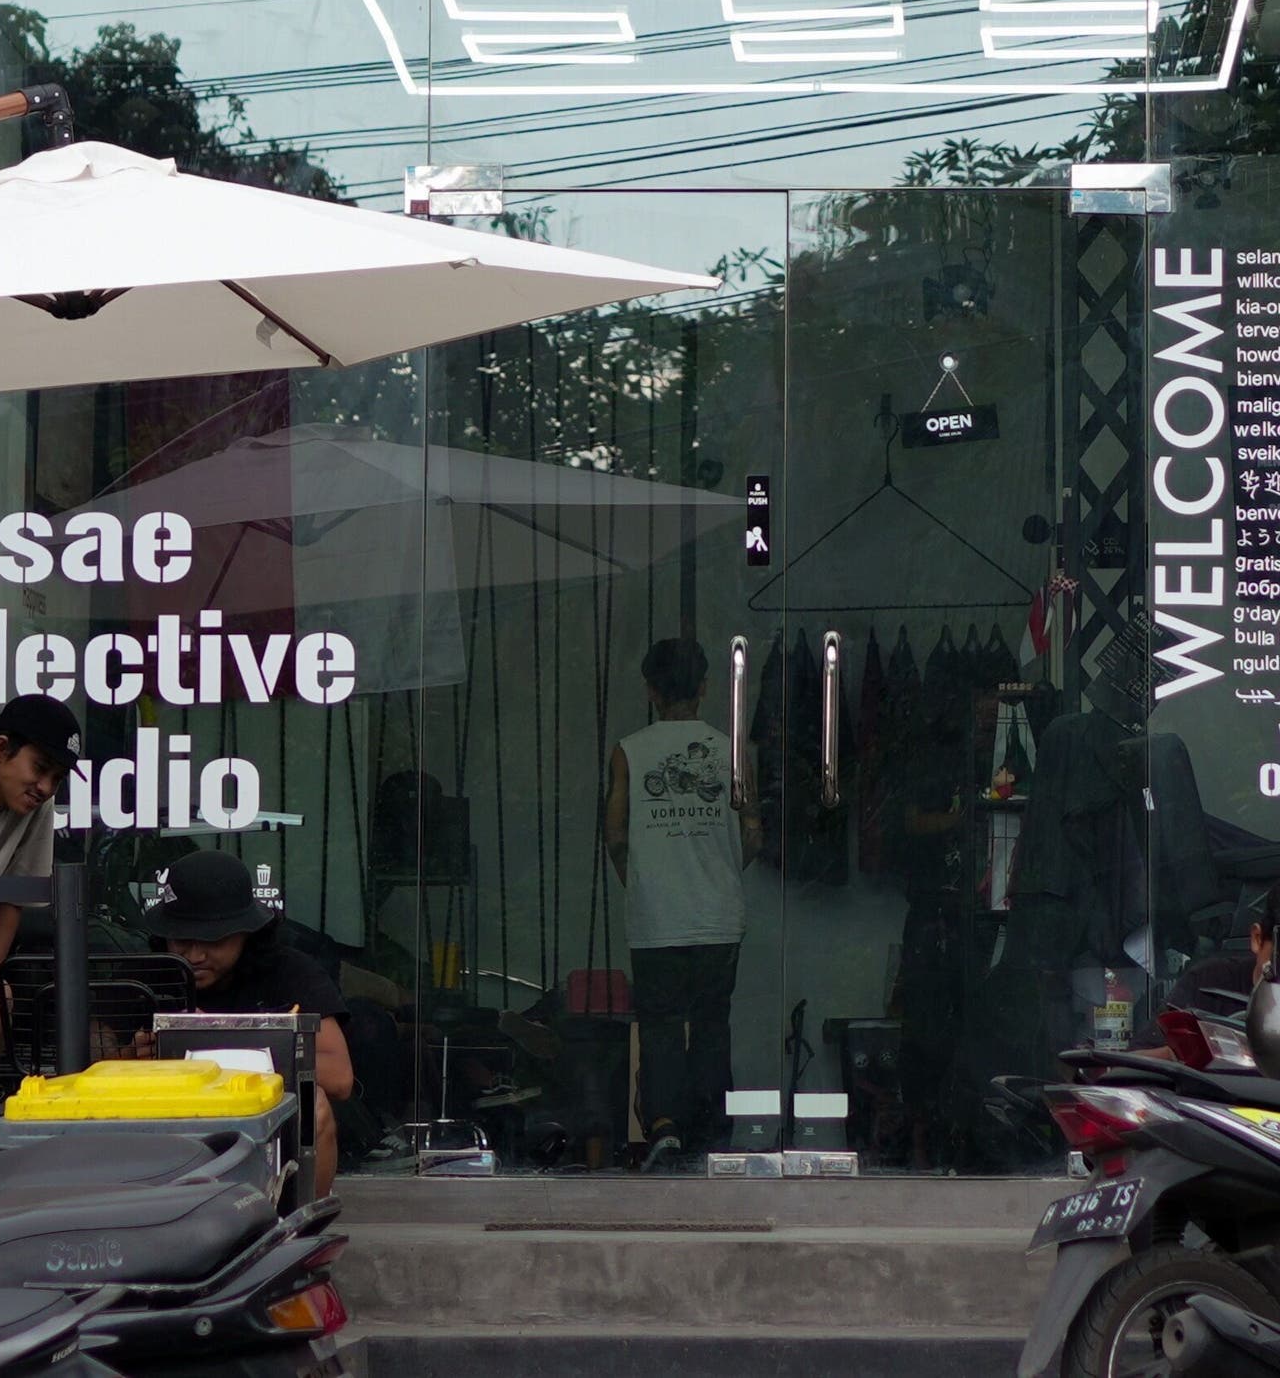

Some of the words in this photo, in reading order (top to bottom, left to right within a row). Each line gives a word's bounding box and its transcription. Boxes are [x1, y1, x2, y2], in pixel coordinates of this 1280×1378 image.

[926, 414, 972, 432] OPEN
[1154, 248, 1225, 699] WELCOME
[748, 497, 768, 506] PUSH
[1233, 606, 1280, 625] g'day
[1235, 629, 1275, 646] bulla
